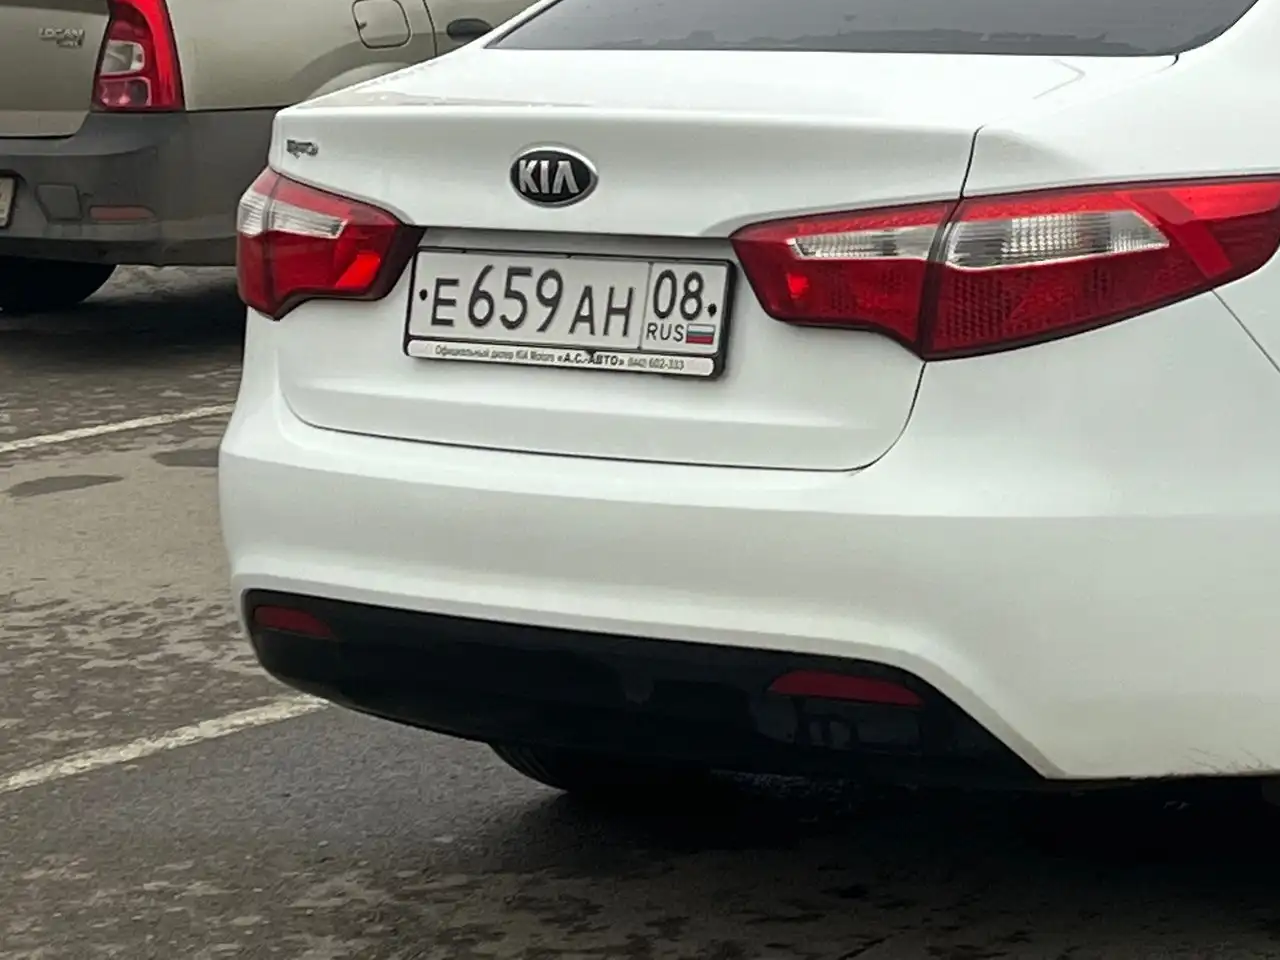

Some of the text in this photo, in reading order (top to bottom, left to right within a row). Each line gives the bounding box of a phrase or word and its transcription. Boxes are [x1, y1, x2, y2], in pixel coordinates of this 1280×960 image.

[519, 160, 580, 194] KIA
[653, 269, 704, 321] 08
[646, 322, 684, 342] RUS
